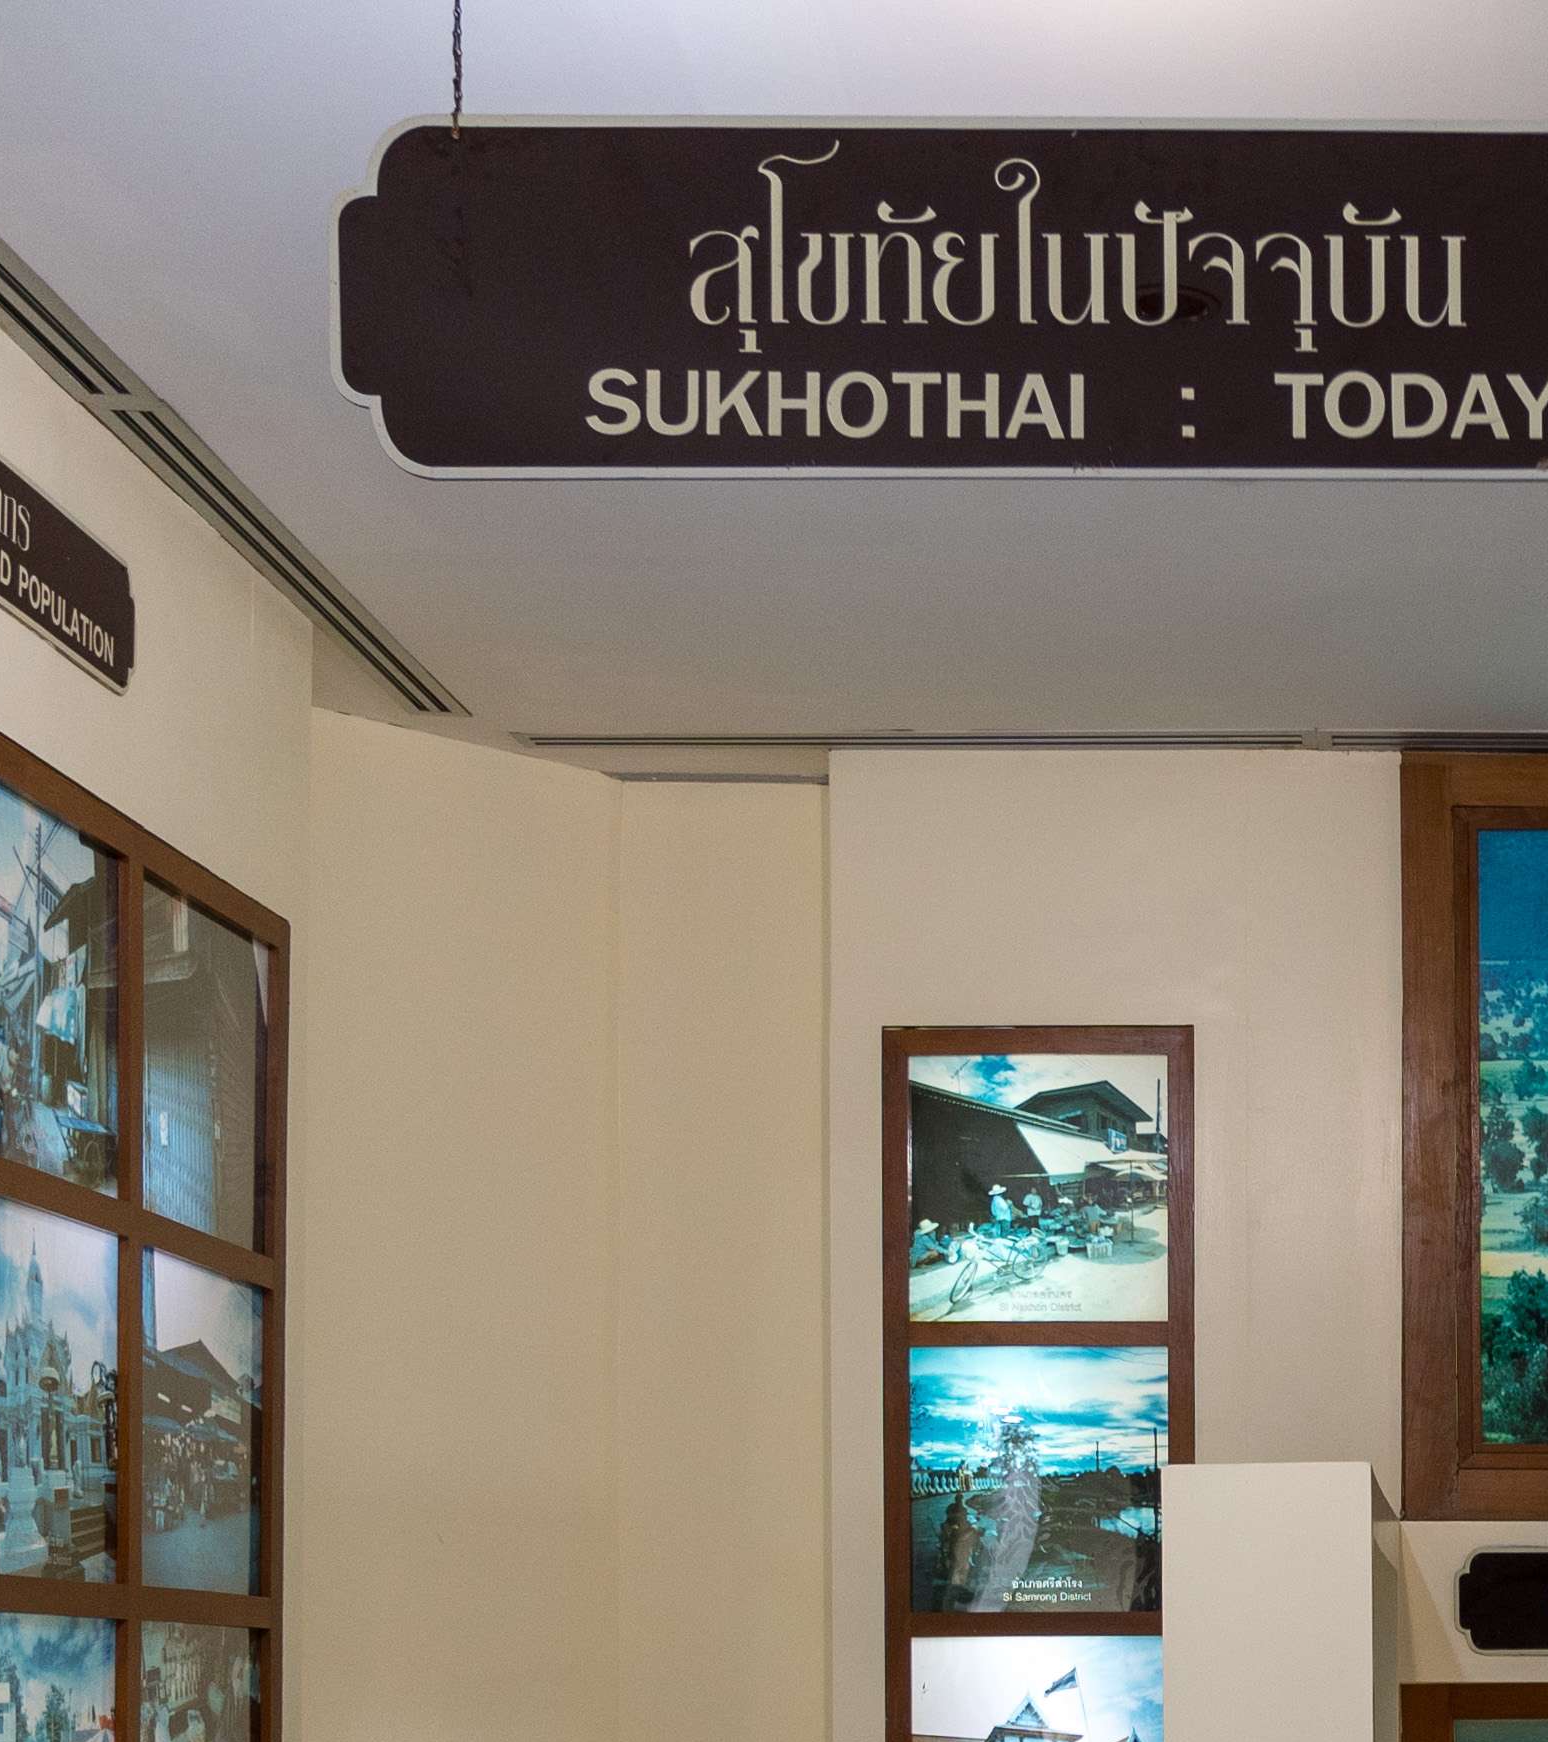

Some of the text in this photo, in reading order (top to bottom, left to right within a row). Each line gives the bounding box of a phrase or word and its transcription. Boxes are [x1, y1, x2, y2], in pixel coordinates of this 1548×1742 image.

[689, 140, 1466, 353] สุโขทัยในปัจจุบัน
[586, 367, 1085, 440] SUKHOTHAI
[1180, 386, 1196, 439] :
[18, 564, 115, 667] POPULATION
[1002, 1592, 1092, 1604] Si Samrong District
